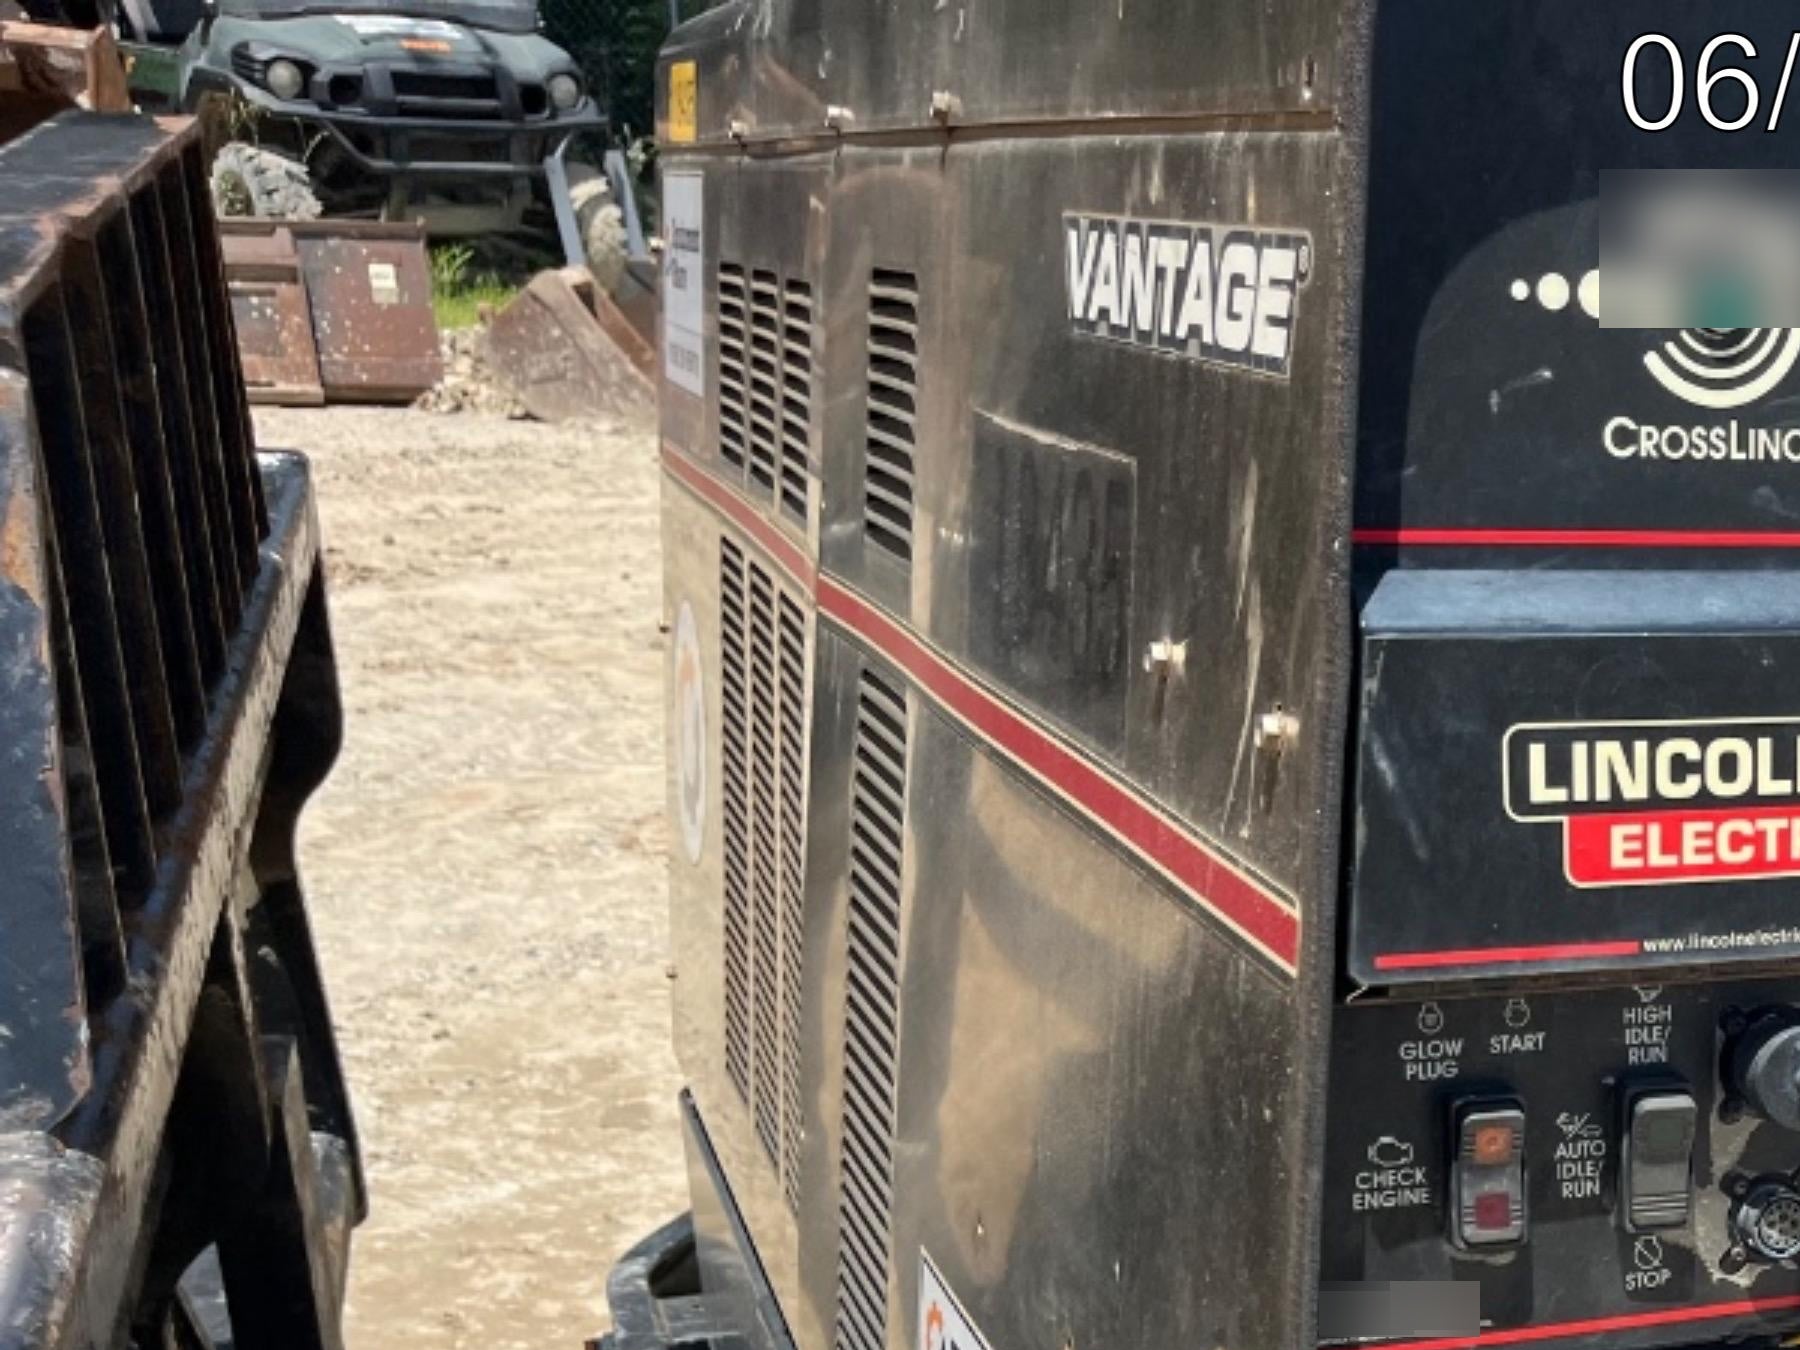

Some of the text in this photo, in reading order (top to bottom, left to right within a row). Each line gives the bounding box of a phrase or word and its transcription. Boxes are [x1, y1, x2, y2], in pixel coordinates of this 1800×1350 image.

[1066, 229, 1297, 358] VANTAGE
[1623, 1004, 1673, 1025] HIGH
[1400, 1037, 1464, 1060] GLOW
[1489, 1031, 1547, 1055] START
[1628, 1046, 1668, 1065] RUN
[1406, 1060, 1459, 1081] PLUG
[1554, 1139, 1606, 1160] AUTO
[1355, 1167, 1428, 1190] CHECK
[1562, 1180, 1600, 1199] RUN
[1353, 1188, 1432, 1211] ENGINE
[1625, 1268, 1672, 1291] STOP
